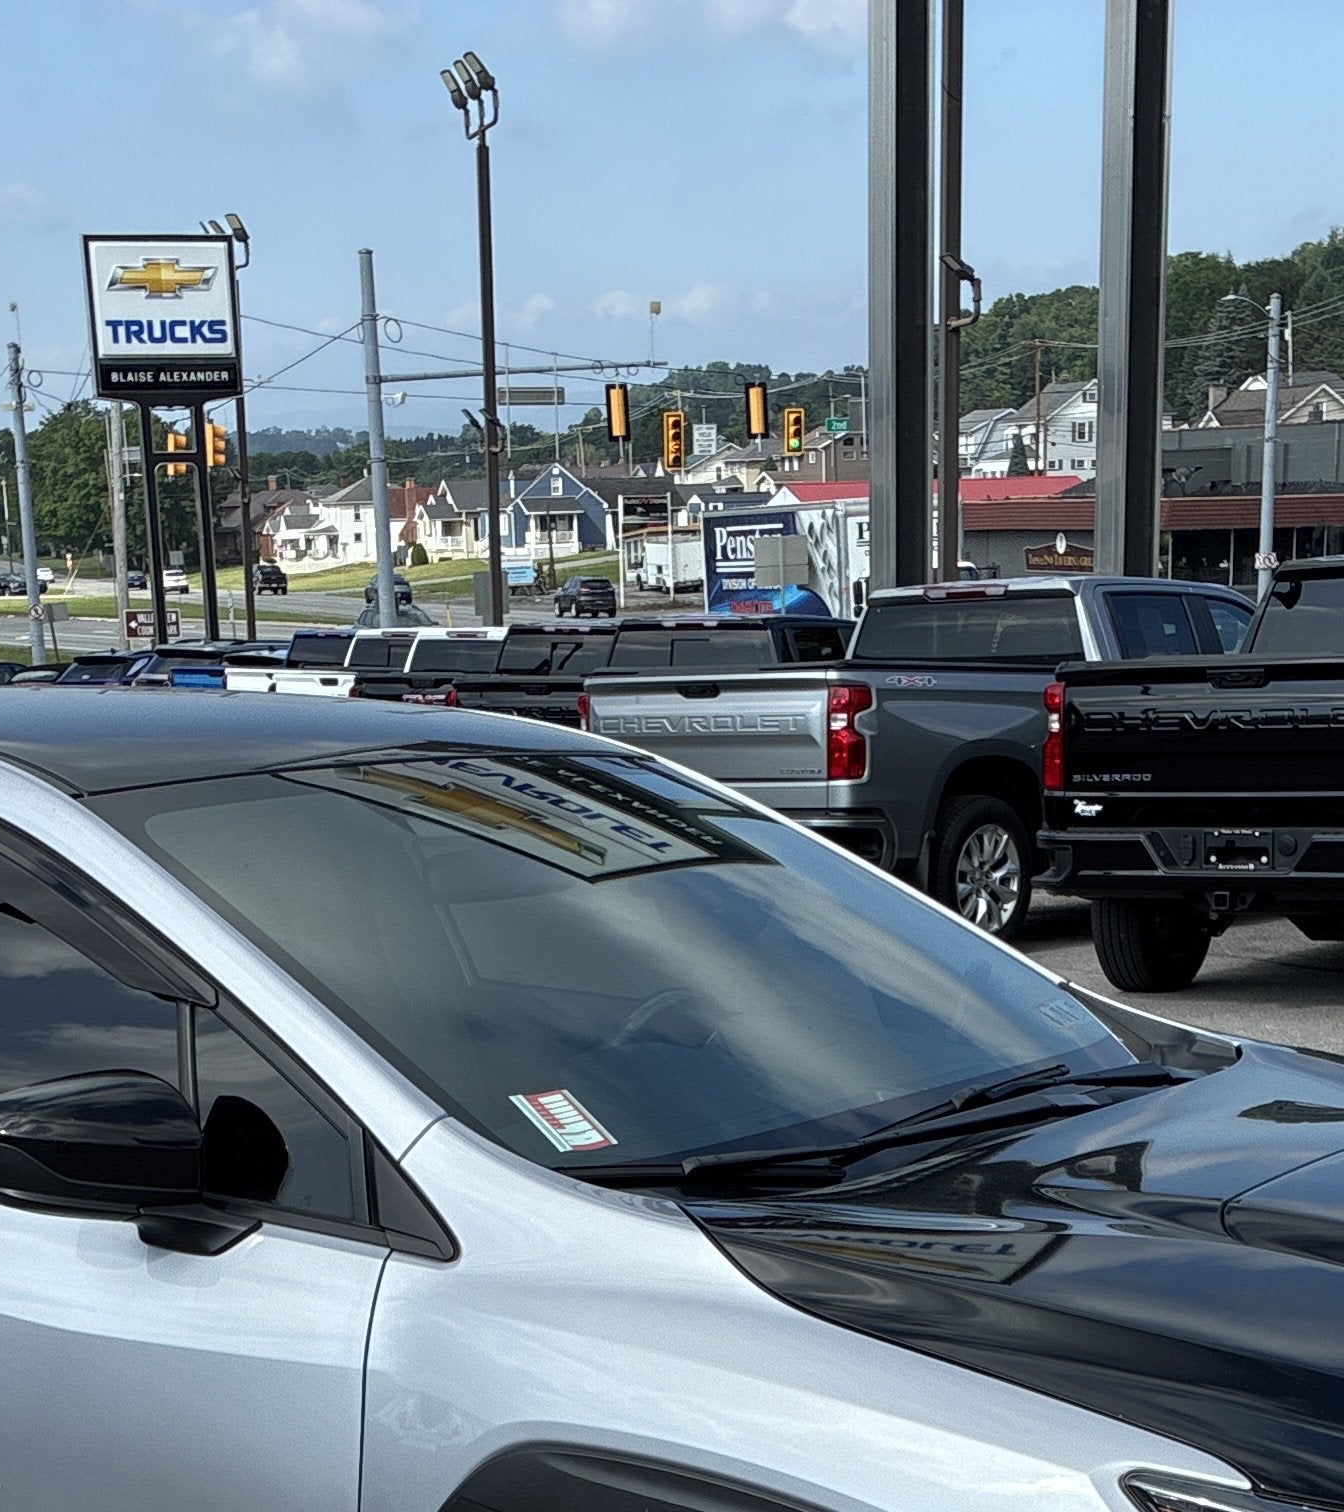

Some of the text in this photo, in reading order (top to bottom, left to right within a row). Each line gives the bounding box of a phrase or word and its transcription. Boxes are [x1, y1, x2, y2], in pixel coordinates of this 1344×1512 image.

[105, 319, 228, 344] TRUCKS
[111, 371, 229, 383] BLAISE ALEXANDER
[831, 420, 848, 430] 2nd
[599, 714, 806, 734] CHEVROLET
[1072, 774, 1153, 783] SILVERADO
